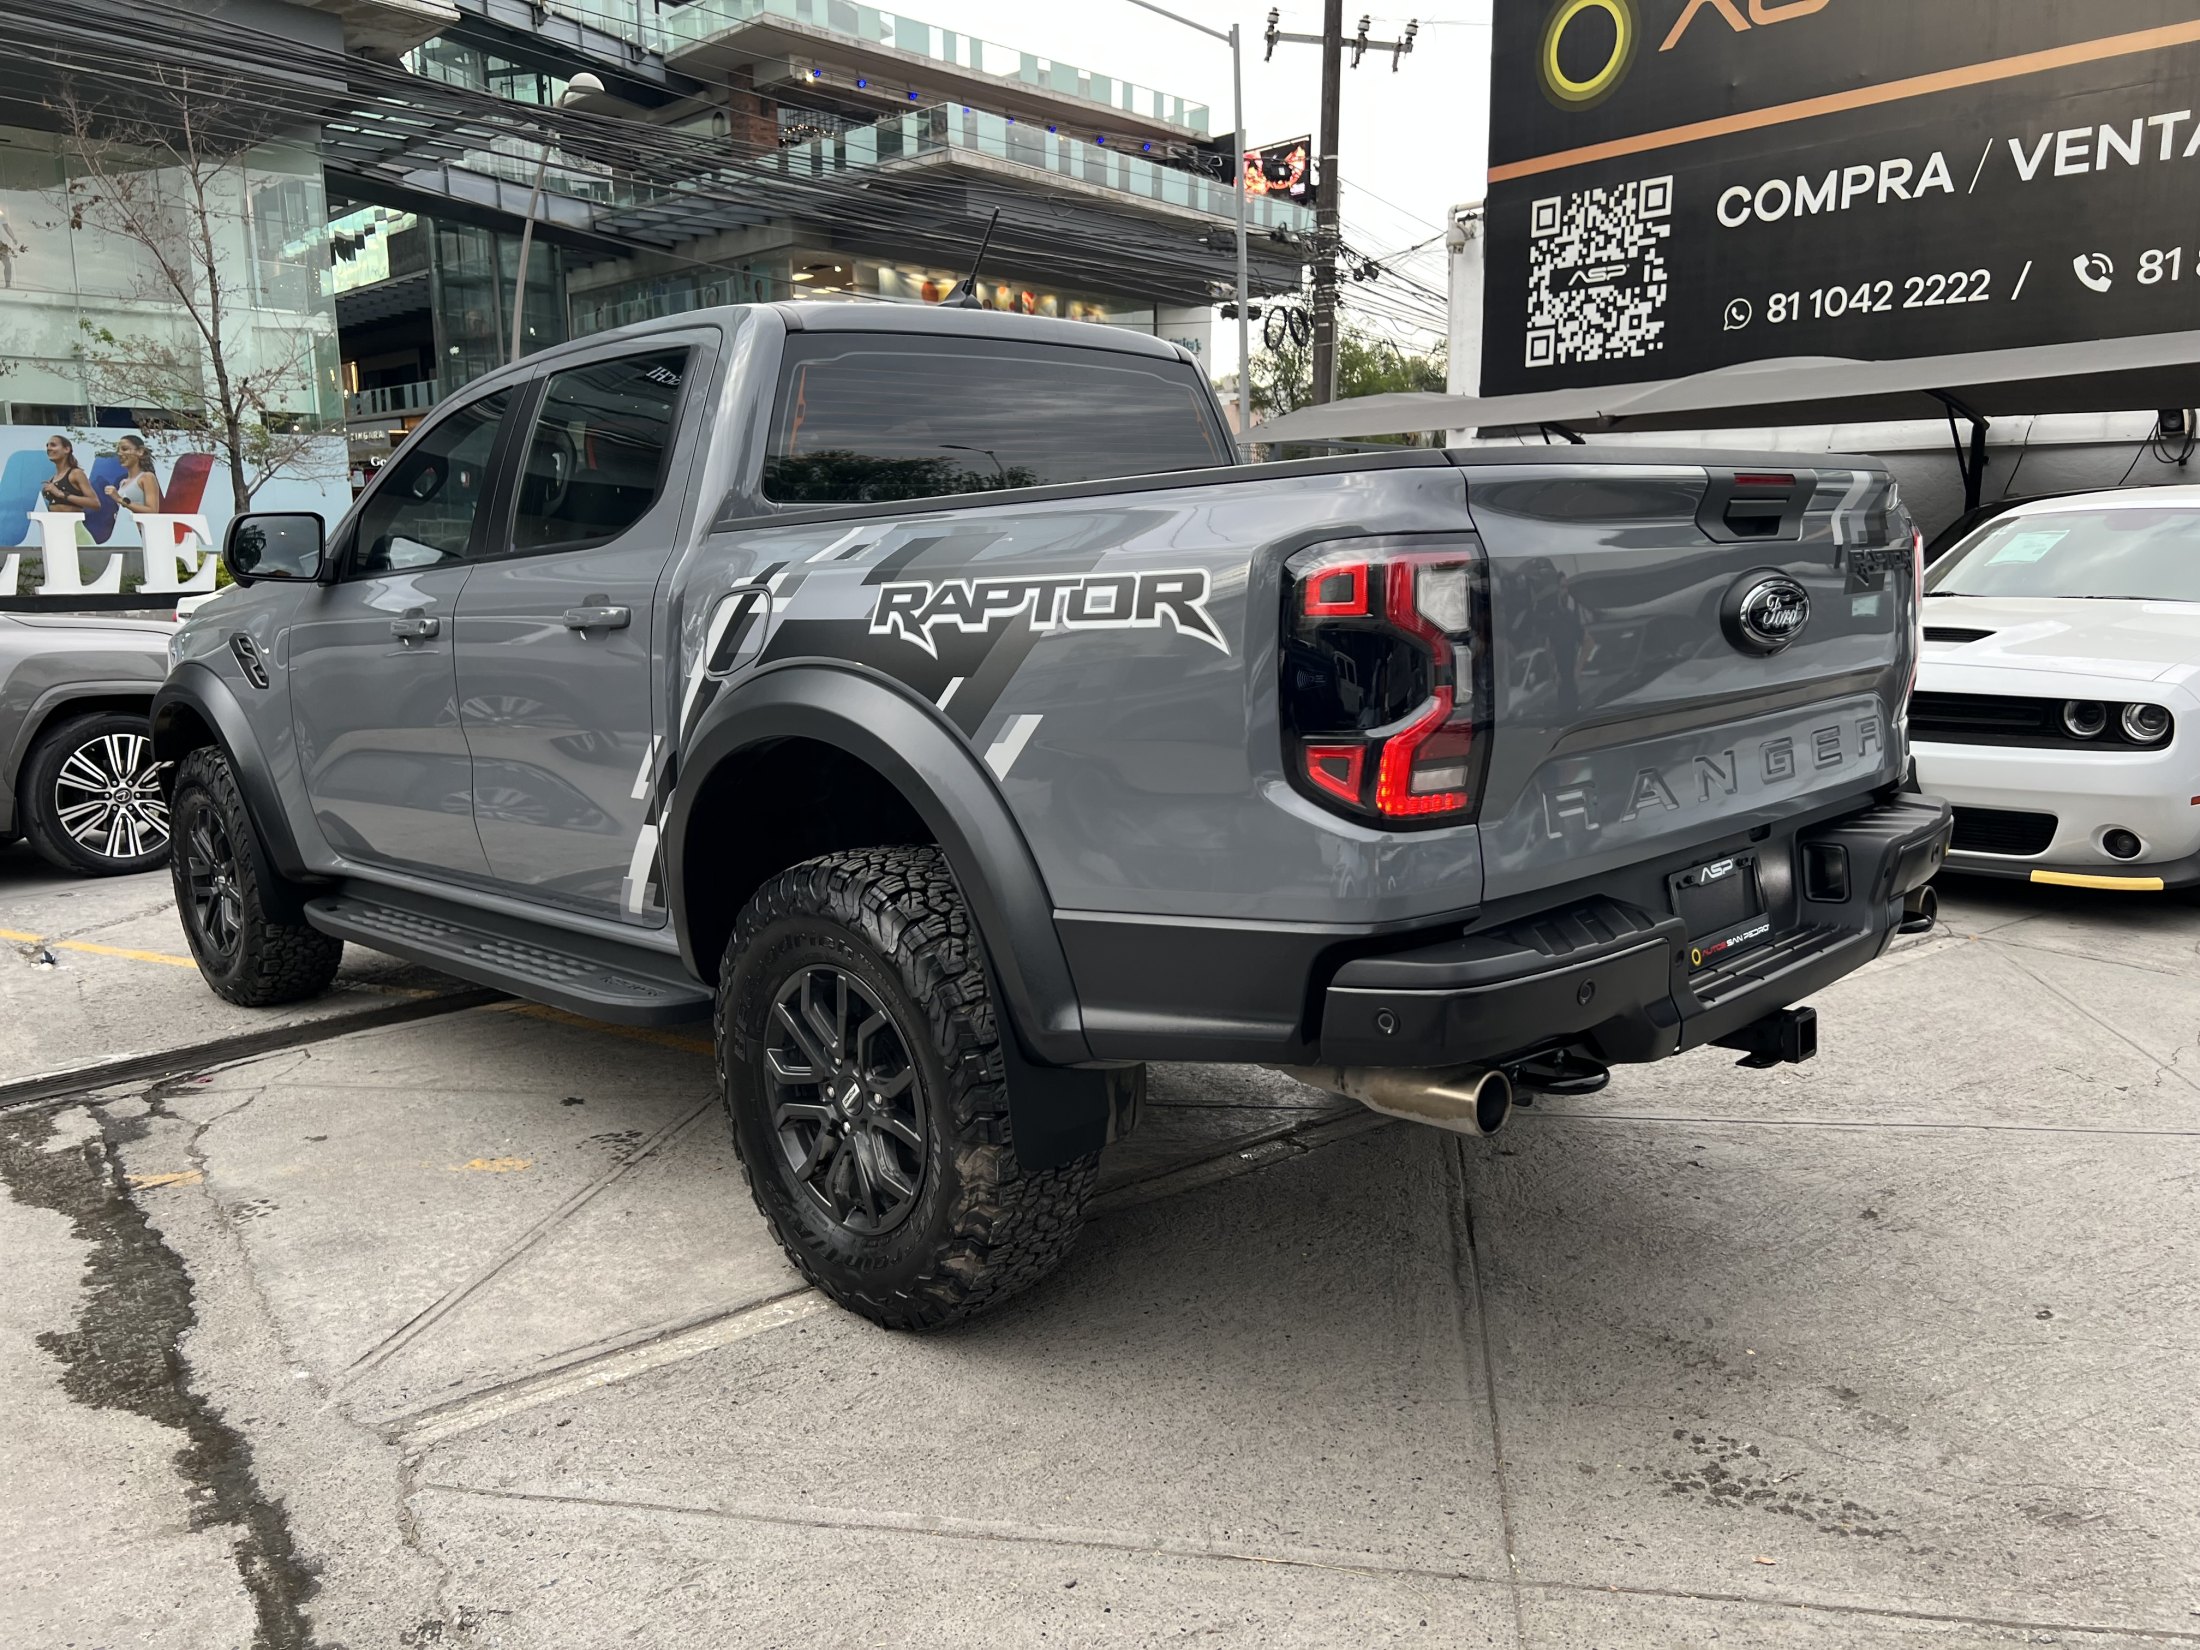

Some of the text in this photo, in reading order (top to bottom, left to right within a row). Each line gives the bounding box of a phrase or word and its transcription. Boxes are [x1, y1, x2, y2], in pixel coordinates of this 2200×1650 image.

[1717, 151, 1955, 228] COMPRA
[1568, 264, 1627, 286] ASP
[1766, 291, 1800, 324] 81
[1809, 280, 1893, 319] 1042
[1902, 269, 1991, 308] 2222
[2136, 246, 2182, 285] 81
[0, 511, 217, 595] LE
[868, 568, 1231, 660] RAPTOR
[1763, 594, 1801, 626] Ford
[1542, 715, 1885, 839] RANGER
[1701, 859, 1733, 882] ASP
[1726, 935, 1743, 947] SAN
